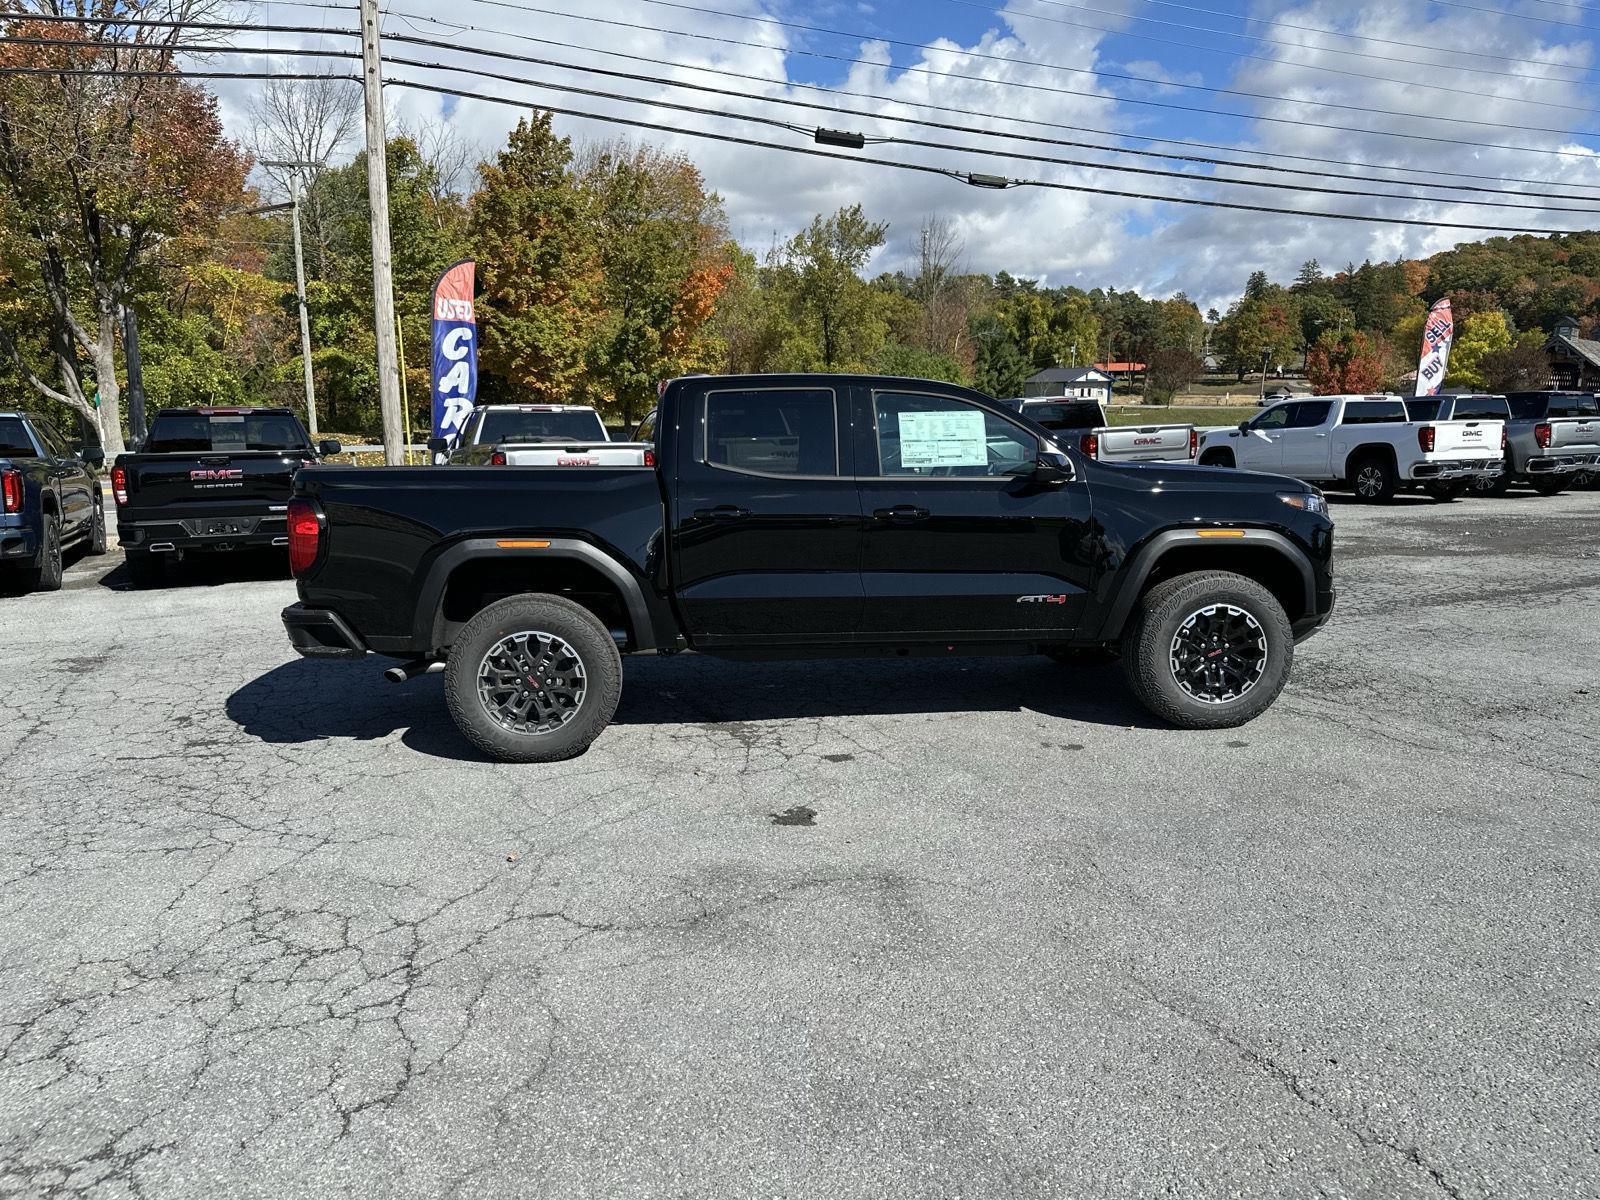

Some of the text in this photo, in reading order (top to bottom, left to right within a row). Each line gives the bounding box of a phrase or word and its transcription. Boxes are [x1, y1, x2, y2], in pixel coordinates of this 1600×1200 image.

[437, 298, 473, 320] USED
[1426, 319, 1452, 344] SELL
[1421, 357, 1444, 380] BUY
[1133, 437, 1162, 446] GMC
[557, 456, 600, 466] GMC
[190, 468, 243, 481] GMC
[1016, 594, 1067, 605] AT4
